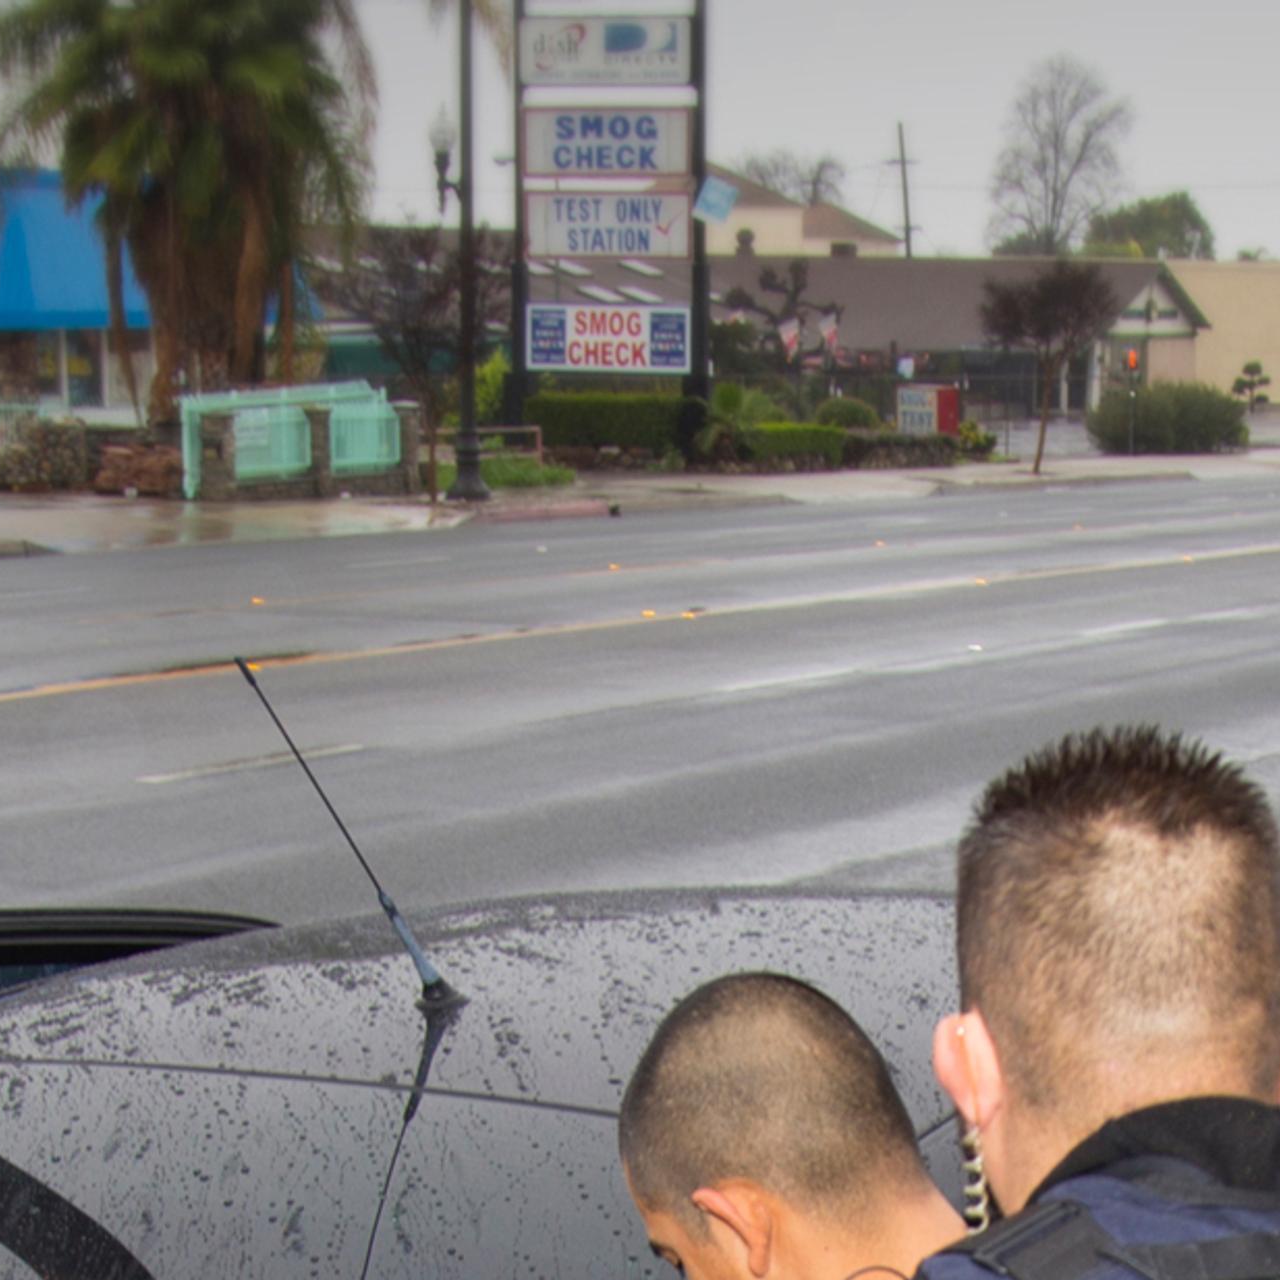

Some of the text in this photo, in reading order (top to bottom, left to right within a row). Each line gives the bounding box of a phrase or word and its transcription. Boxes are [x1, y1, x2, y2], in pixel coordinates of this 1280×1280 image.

[555, 115, 658, 140] SMOG
[553, 145, 658, 169] CHECK
[553, 198, 662, 222] TEST ONLY
[568, 228, 650, 252] STATION
[574, 310, 641, 336] SMOG
[568, 341, 647, 367] CHECK
